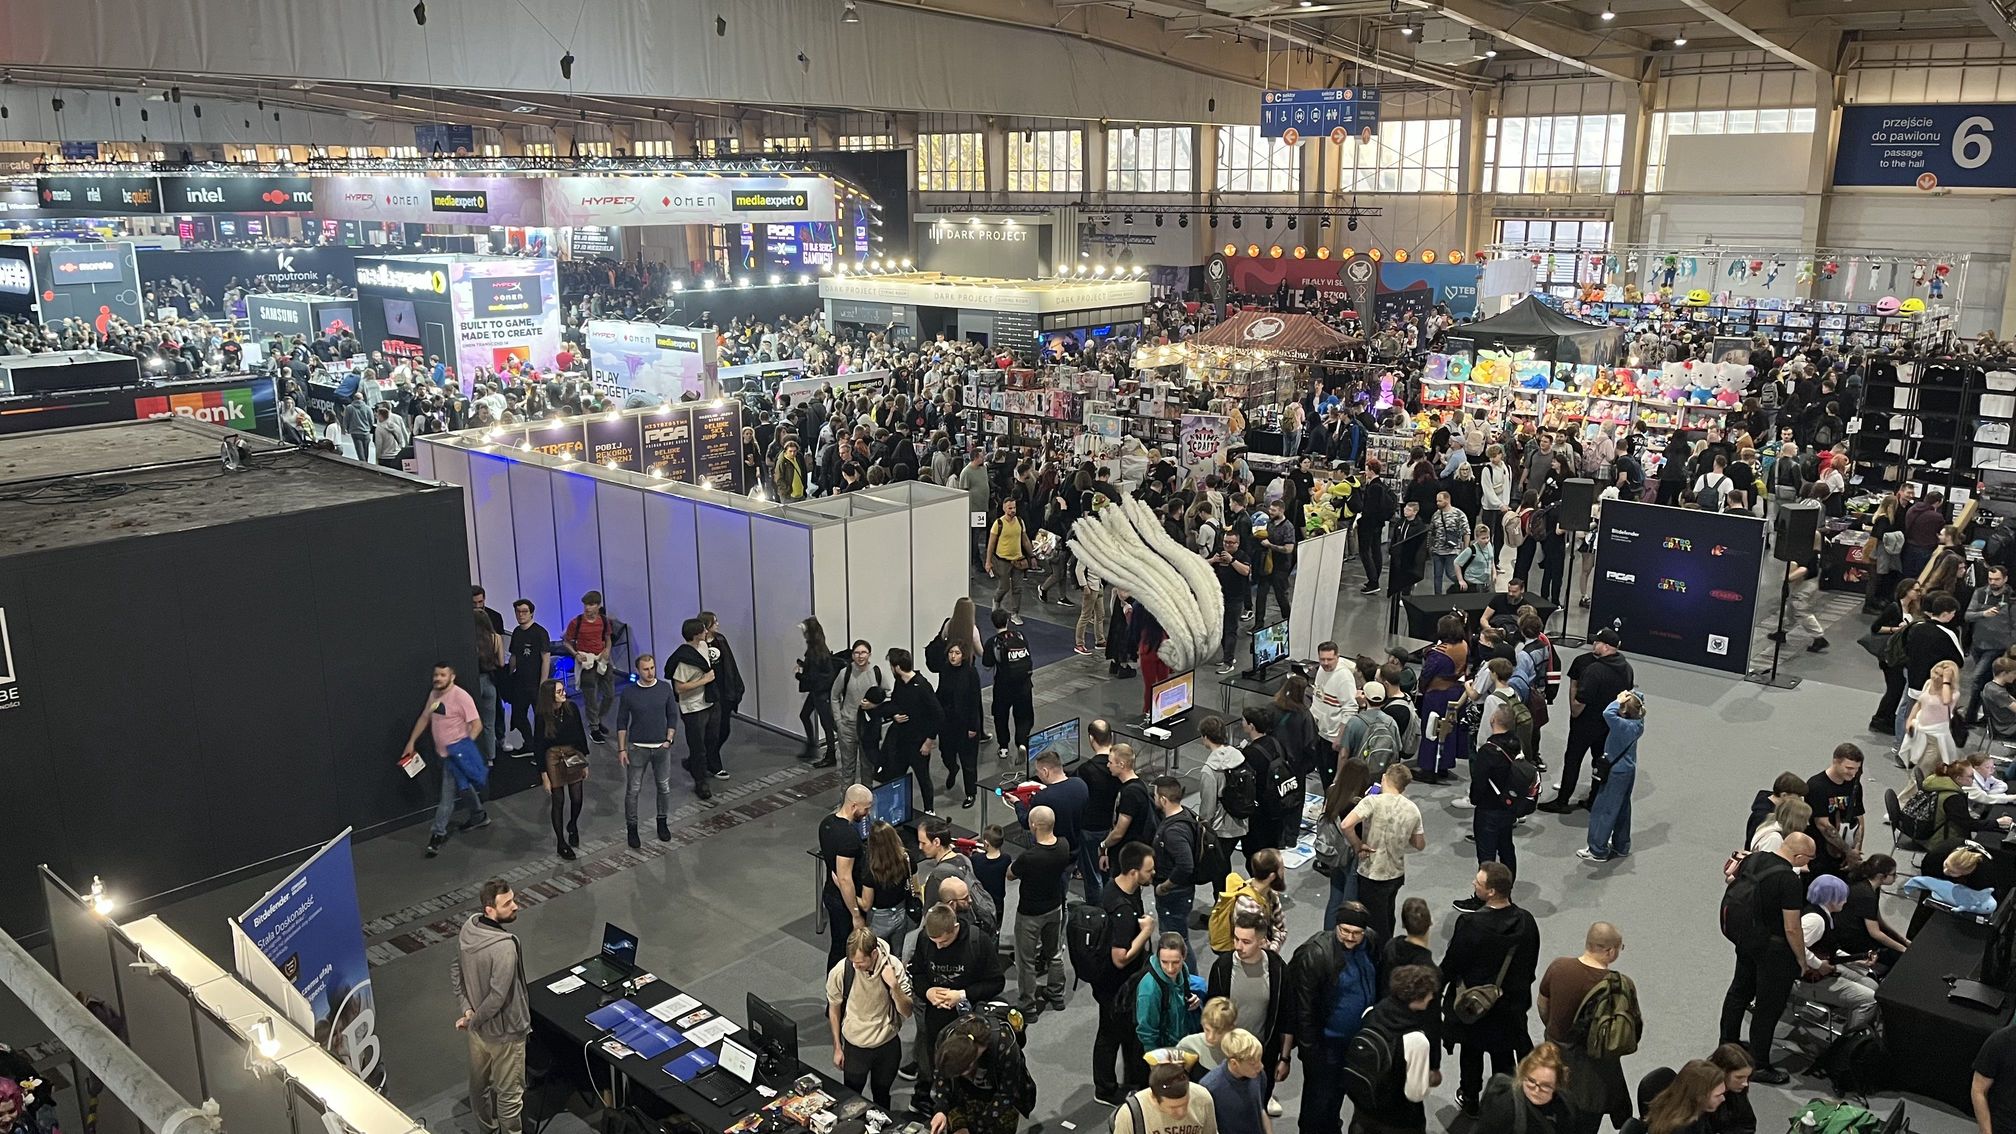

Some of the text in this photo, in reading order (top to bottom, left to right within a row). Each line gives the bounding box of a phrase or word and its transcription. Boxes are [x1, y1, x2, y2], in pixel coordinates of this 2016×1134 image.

[1275, 93, 1282, 102] C
[1336, 90, 1342, 100] B
[1882, 117, 1933, 129] przejście
[1872, 115, 1995, 169] do pawilonu 6
[1884, 149, 1923, 159] passage
[1880, 159, 1925, 168] to the hall
[393, 196, 419, 205] OMEN
[434, 195, 478, 208] mediaexpert
[674, 196, 716, 206] OMEN
[736, 195, 795, 208] mediaexpert
[947, 229, 1027, 241] DARK PROJECT
[1458, 286, 1476, 295] TEB
[934, 292, 955, 301] DARK
[958, 293, 993, 304] PROJECT
[1056, 296, 1074, 305] DARK
[1077, 293, 1107, 303] PROJECT
[260, 306, 298, 324] SAMSUNG
[461, 318, 535, 330] BUILT TO GAME,
[462, 331, 490, 341] MADE
[507, 328, 543, 338] CREATE
[596, 370, 619, 385] PLAY
[597, 383, 647, 399] TOGETH
[704, 422, 729, 430] DELUXE
[645, 426, 689, 444] PGA
[721, 431, 734, 439] 2.1
[595, 442, 623, 452] POBIJ
[596, 447, 633, 460] REKORDY
[1662, 541, 1692, 552] GRATY
[1657, 582, 1687, 593] GRATY
[1277, 776, 1298, 797] VANS
[253, 893, 290, 928] Bitdefender
[274, 894, 314, 935] Doskonałość
